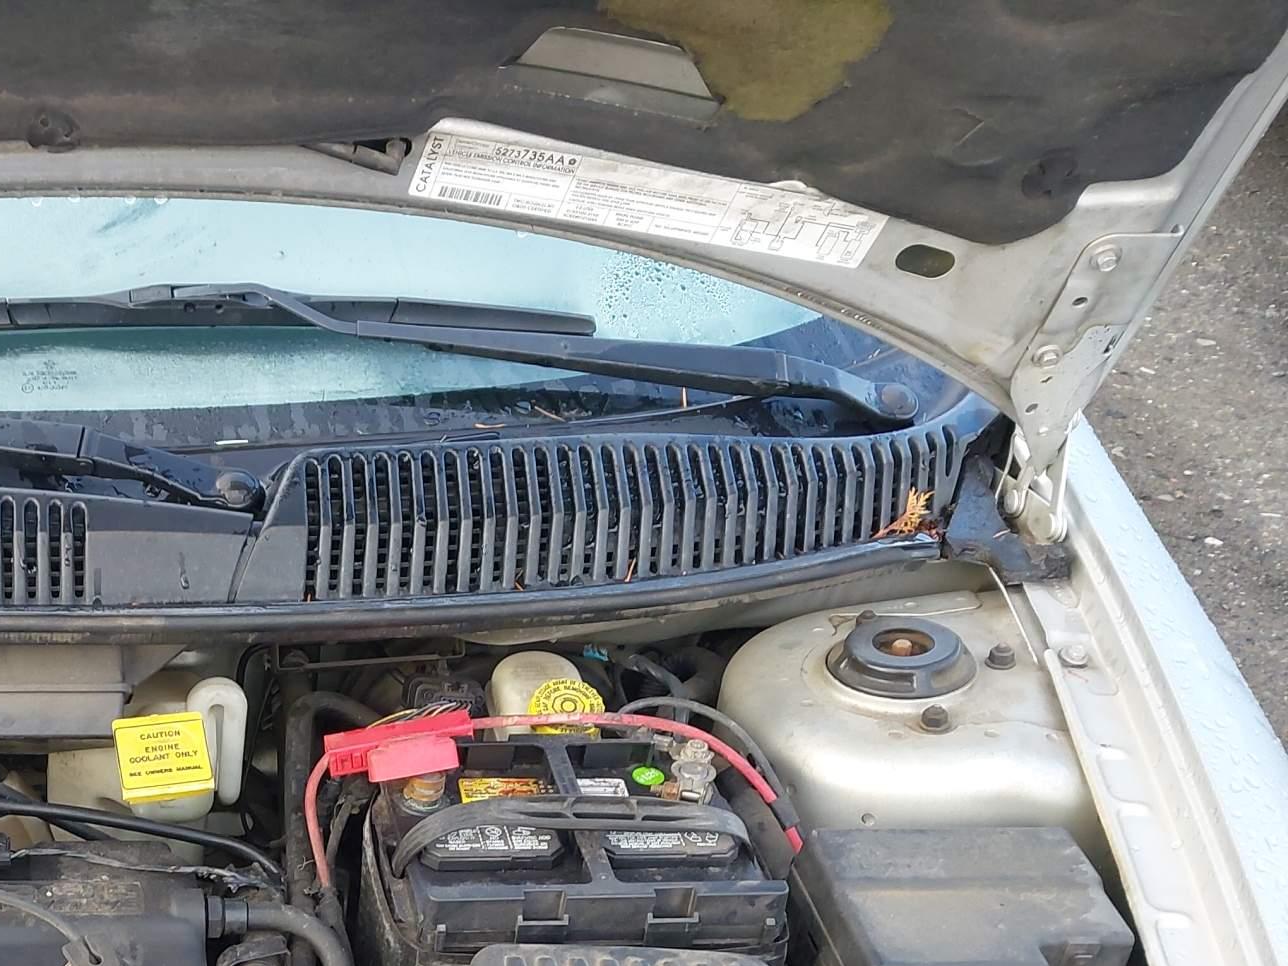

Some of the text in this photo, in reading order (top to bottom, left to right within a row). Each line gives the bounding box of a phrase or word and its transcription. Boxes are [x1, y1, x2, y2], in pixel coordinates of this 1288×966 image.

[494, 146, 565, 166] 5273735AA
[416, 136, 445, 192] CATALYST
[503, 157, 531, 168] CONTROL
[532, 161, 576, 174] INFORMATION
[140, 730, 180, 740] CAUTION
[145, 743, 180, 753] ENGINE
[129, 750, 198, 764] COOLANT ONLY
